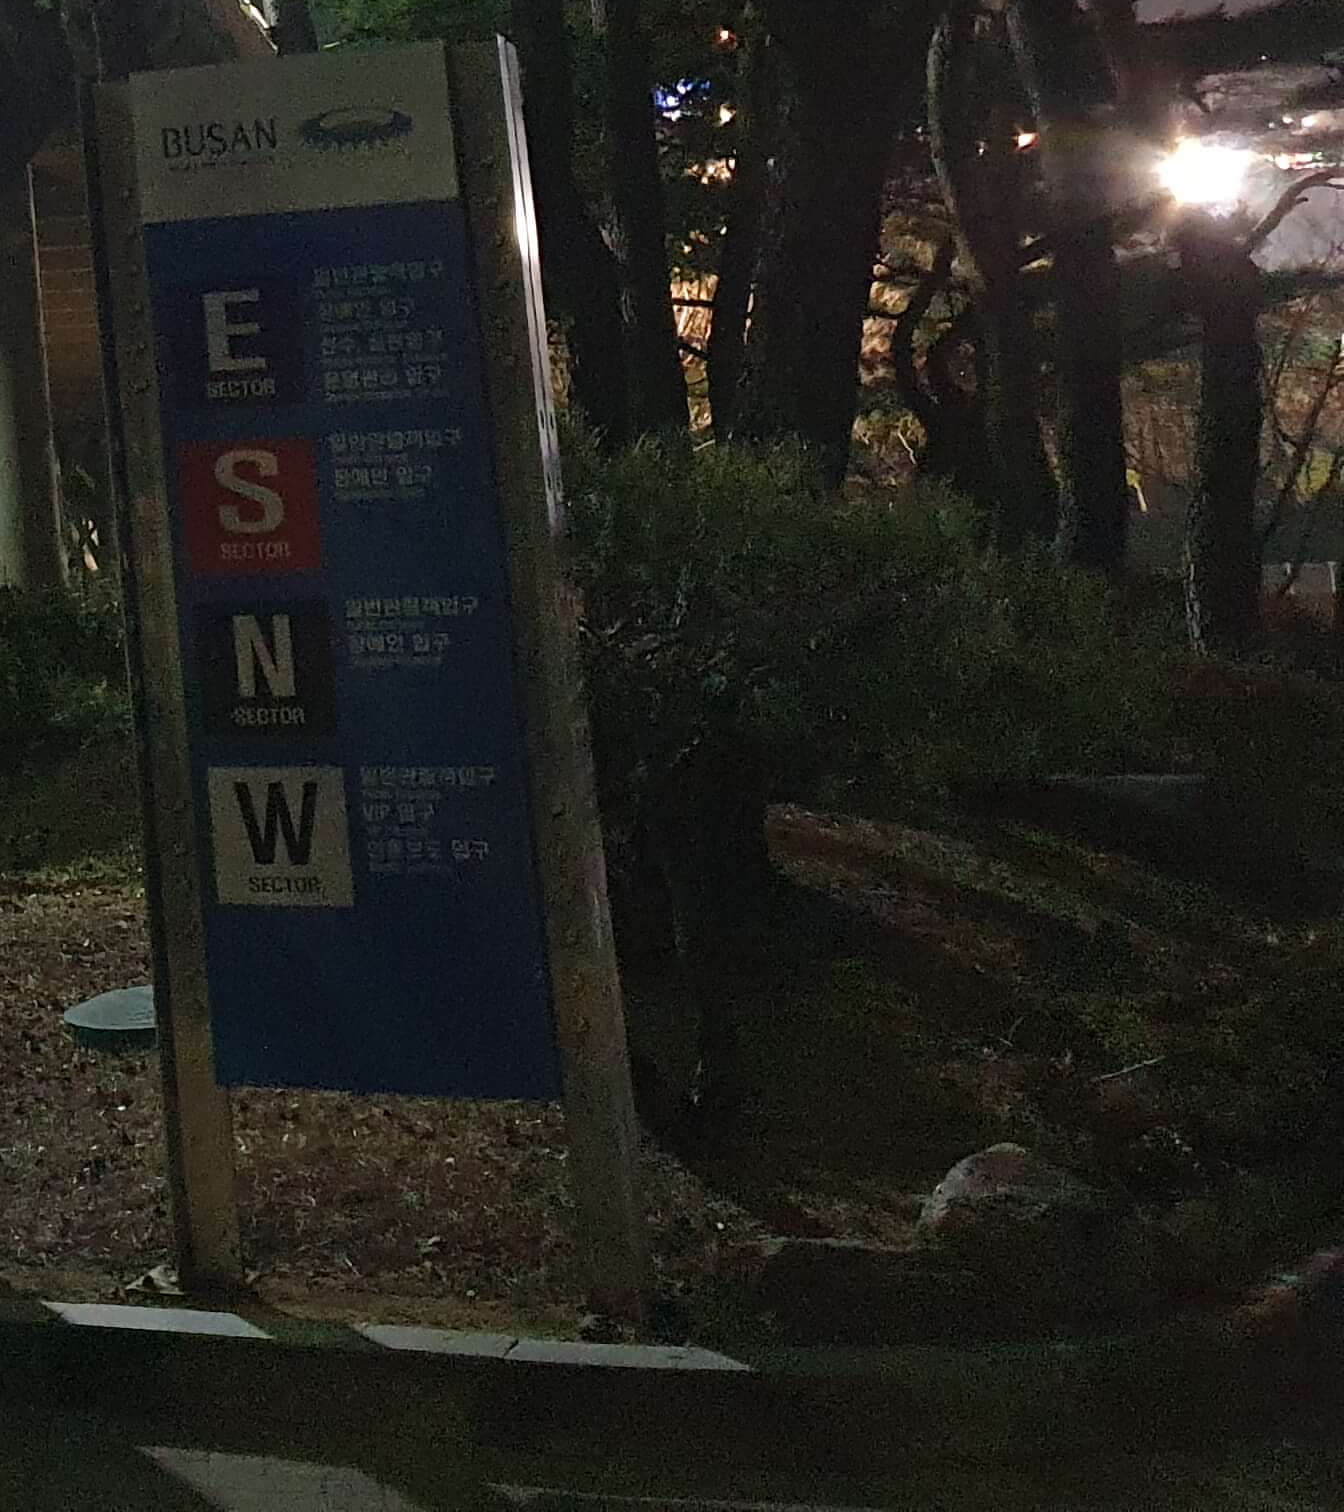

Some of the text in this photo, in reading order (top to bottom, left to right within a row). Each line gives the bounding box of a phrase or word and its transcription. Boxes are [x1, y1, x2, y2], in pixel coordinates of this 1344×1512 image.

[162, 118, 278, 159] BUSAN
[202, 287, 267, 373] E
[207, 378, 276, 399] SECTOR
[214, 447, 286, 535] S
[219, 541, 291, 561] SECTOR
[231, 613, 297, 698] N
[234, 704, 306, 726] SECTOR
[233, 780, 318, 866] W
[247, 875, 323, 894] SECTOR
